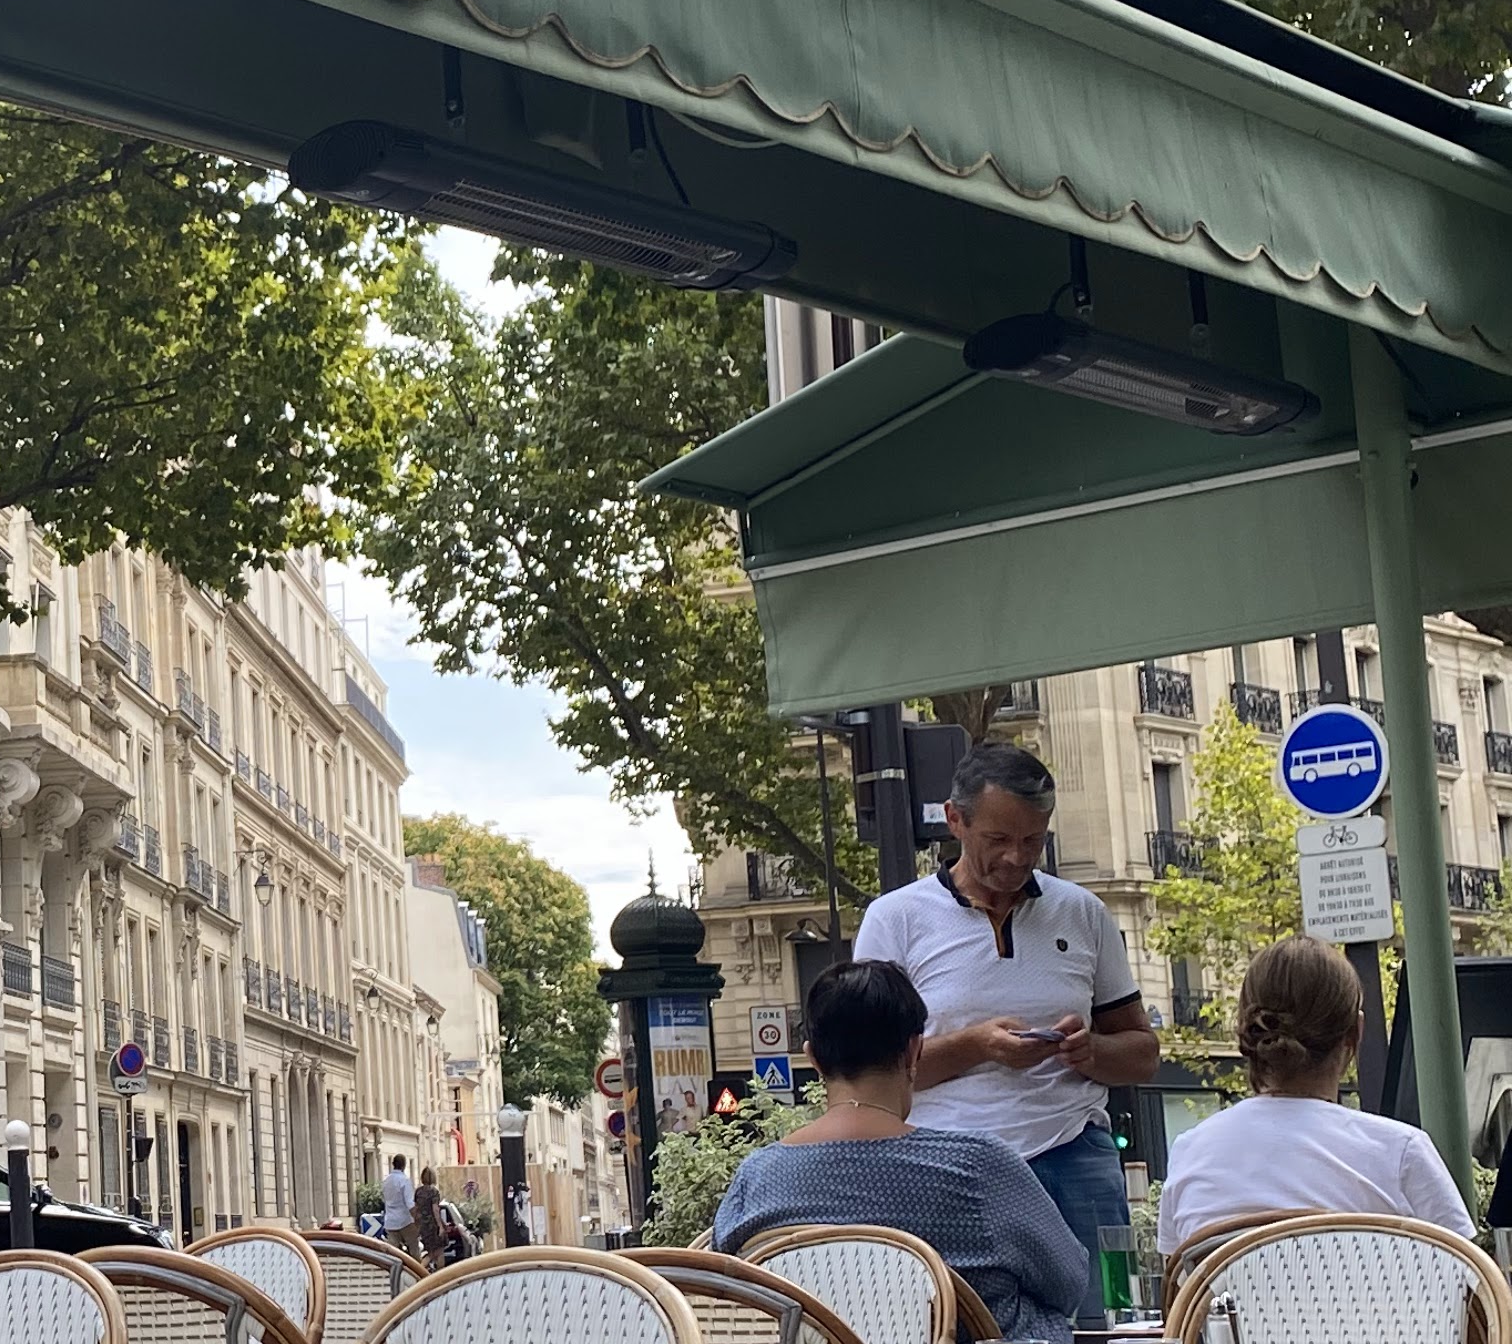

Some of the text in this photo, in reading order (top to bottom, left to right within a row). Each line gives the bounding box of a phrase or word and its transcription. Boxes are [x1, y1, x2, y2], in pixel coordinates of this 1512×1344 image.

[756, 1011, 781, 1020] ZONE
[764, 1030, 777, 1040] 30
[653, 1048, 709, 1077] RUMB
